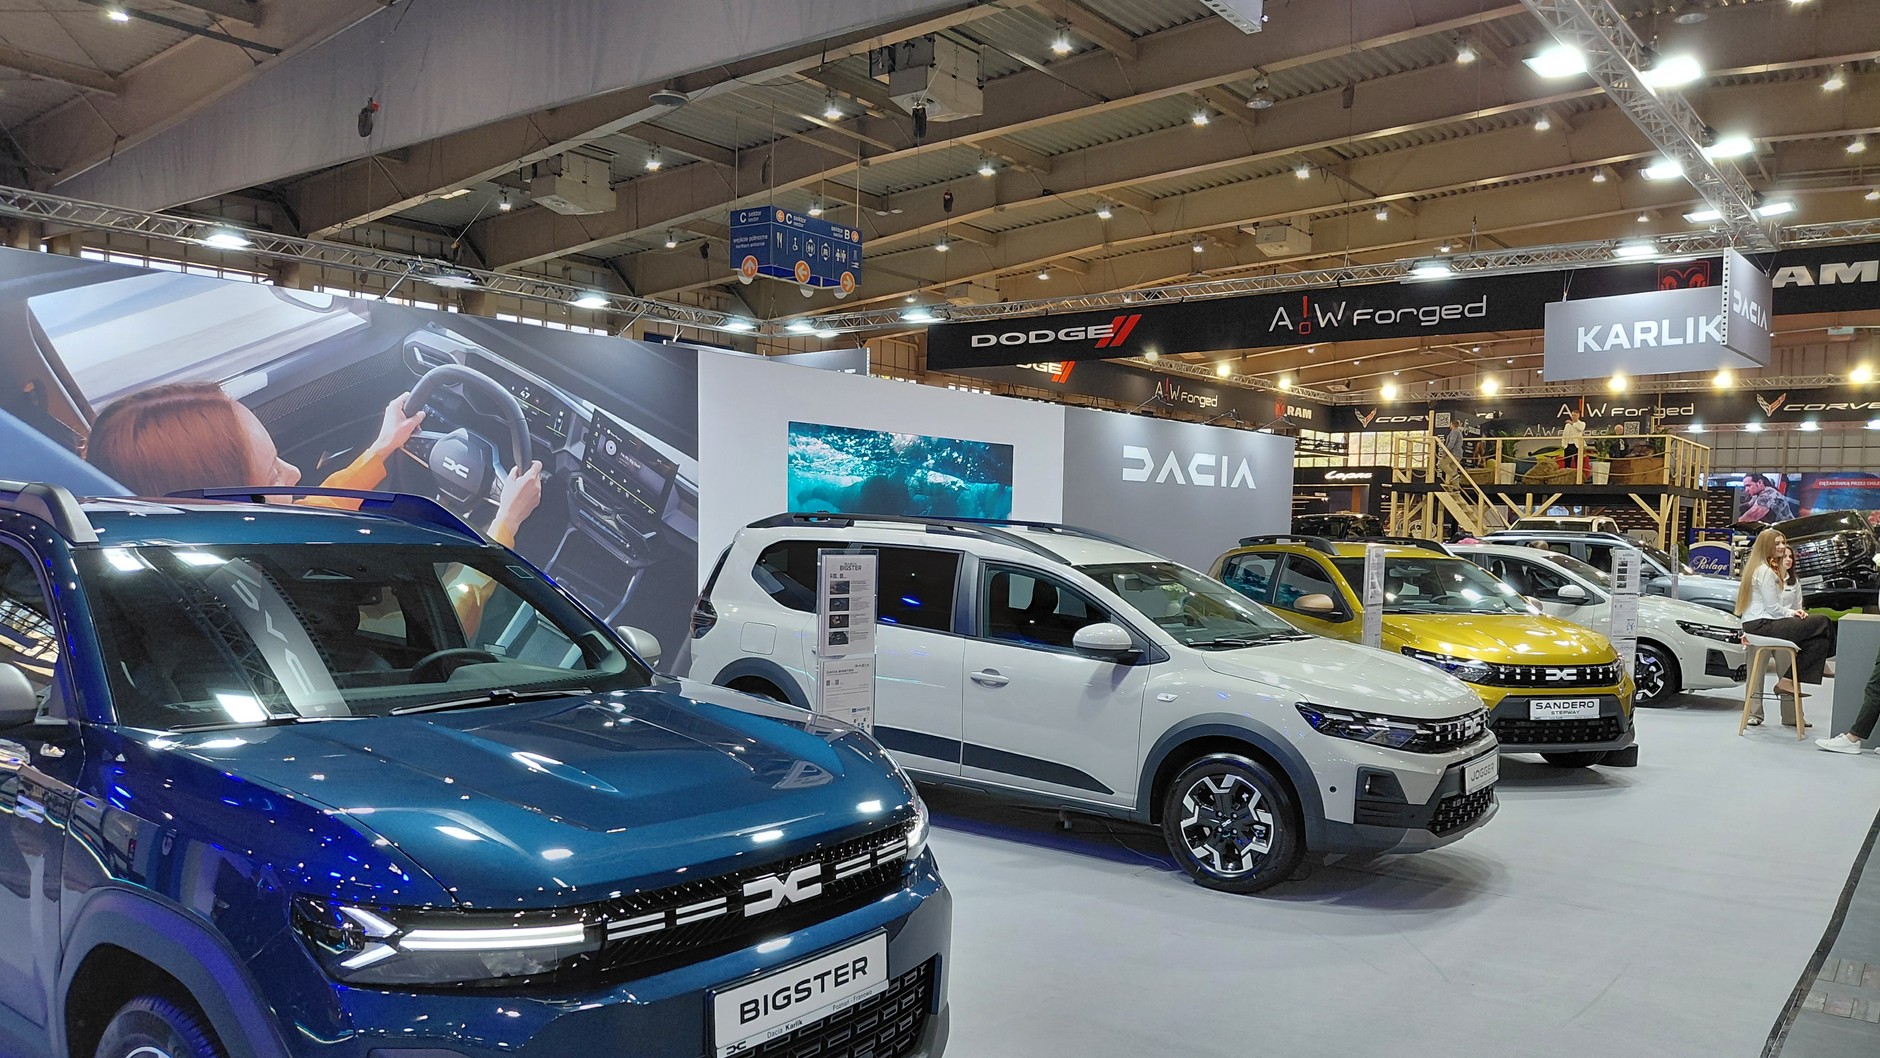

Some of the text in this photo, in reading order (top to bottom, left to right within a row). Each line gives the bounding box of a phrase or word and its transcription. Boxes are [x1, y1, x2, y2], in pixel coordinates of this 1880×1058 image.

[740, 212, 747, 223] C
[786, 213, 793, 225] C
[844, 229, 851, 240] B
[1772, 260, 1880, 288] AM
[1732, 288, 1768, 331] DACIA
[971, 323, 1115, 348] DODGE
[1577, 314, 1722, 353] KARLIK
[1286, 405, 1312, 420] RAM
[1783, 401, 1880, 411] CORVE
[1122, 445, 1257, 490] DACIA
[1535, 700, 1595, 710] SANDERO
[1471, 762, 1495, 782] JOGGER
[740, 956, 868, 1025] BIGSTER
[767, 1029, 783, 1039] Dacia
[785, 1020, 803, 1031] Karlik
